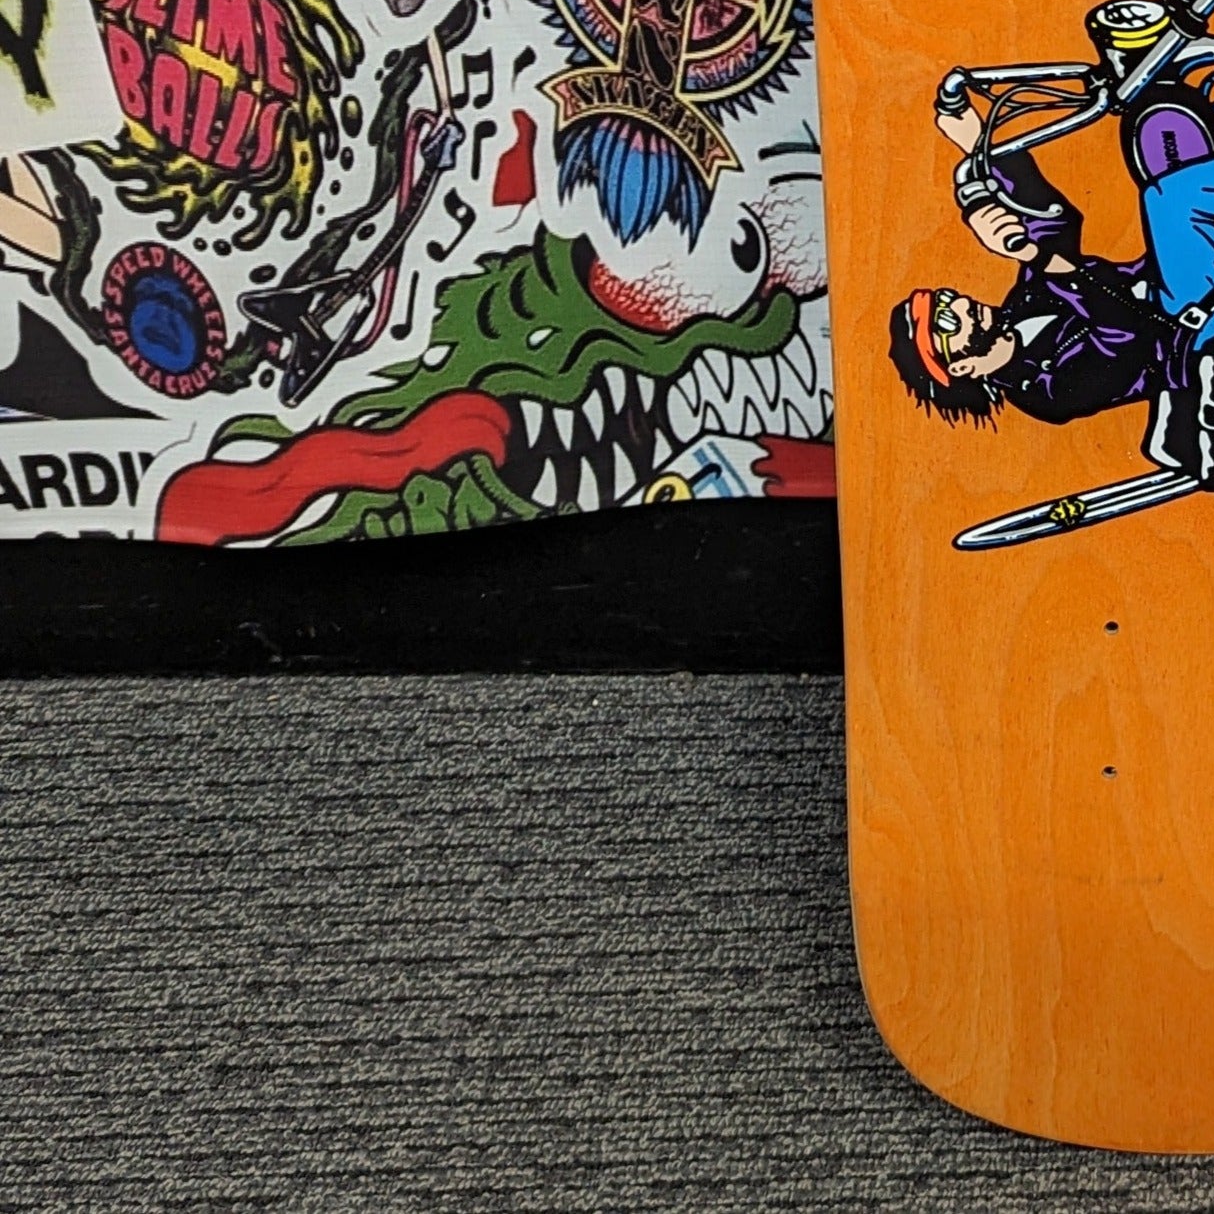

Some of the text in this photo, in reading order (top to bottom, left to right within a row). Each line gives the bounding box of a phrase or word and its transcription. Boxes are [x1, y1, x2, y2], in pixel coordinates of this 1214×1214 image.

[106, 23, 284, 170] BALLS
[105, 246, 224, 361] SPEED WHEELS
